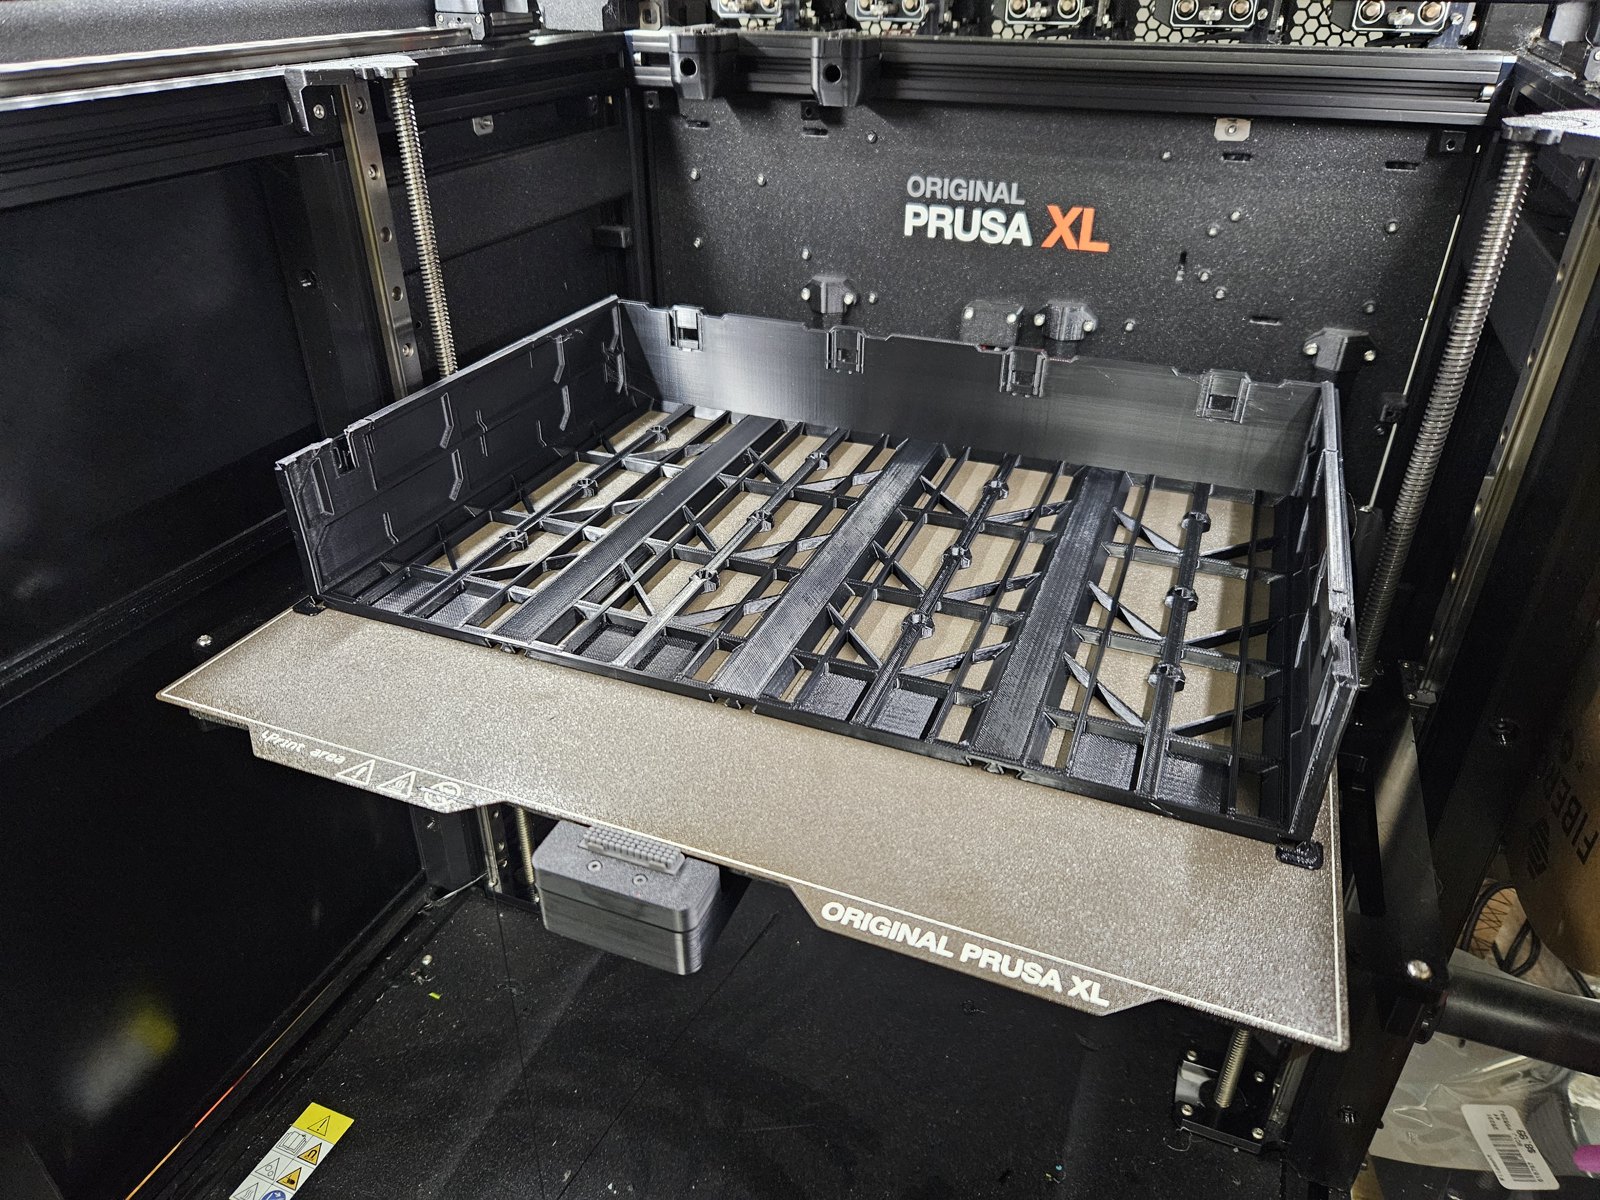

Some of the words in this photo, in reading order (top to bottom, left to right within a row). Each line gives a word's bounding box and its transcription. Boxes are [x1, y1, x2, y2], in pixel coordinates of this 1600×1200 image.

[906, 175, 1026, 205] ORIGINAL
[904, 202, 1033, 247] PRUSA
[1041, 204, 1110, 253] XL
[309, 747, 346, 765] area
[821, 902, 954, 958] ORIGINAL
[959, 943, 1063, 993] PRUSA
[1067, 975, 1110, 1008] XL
